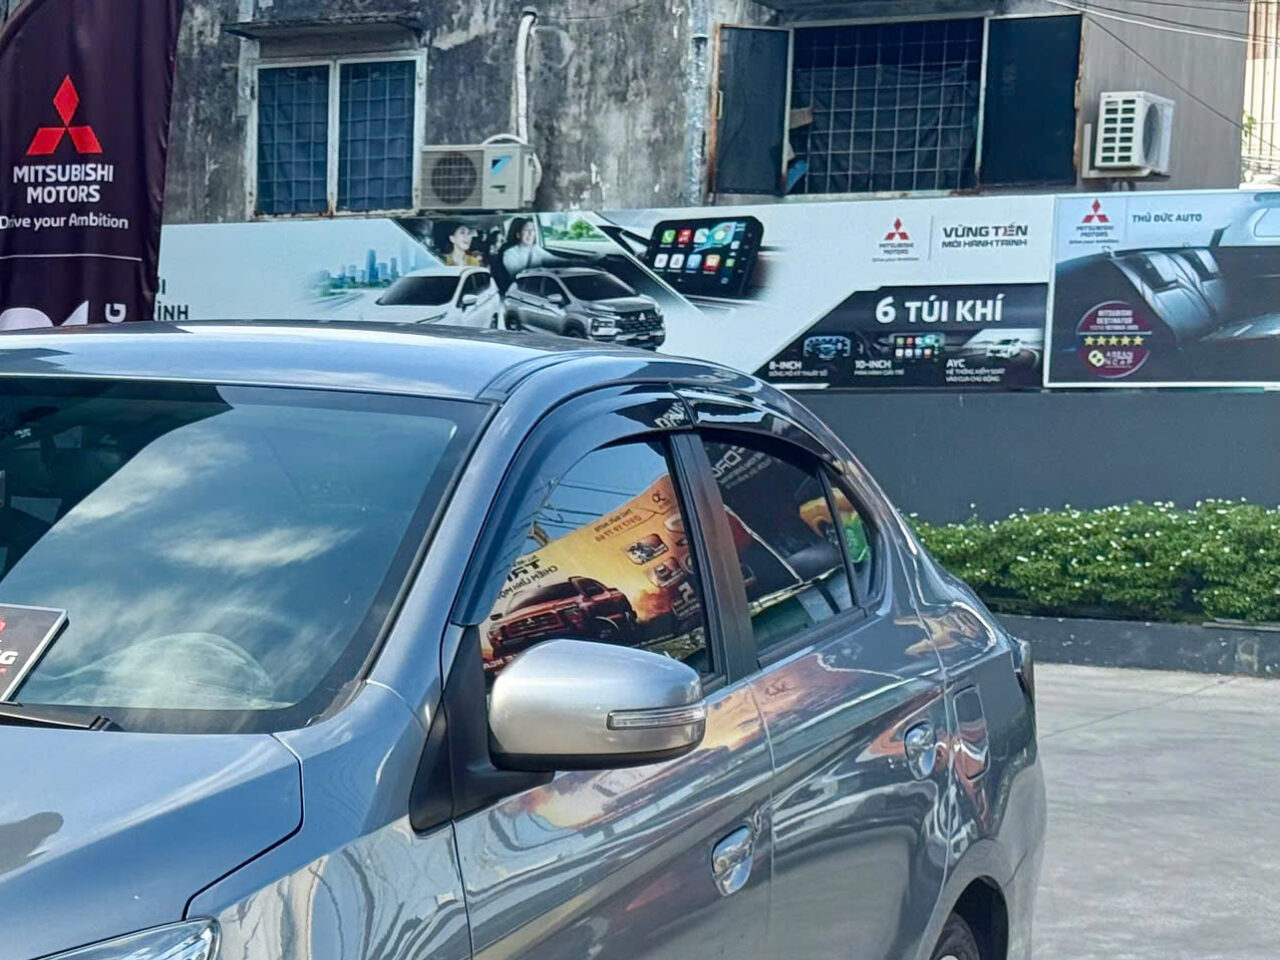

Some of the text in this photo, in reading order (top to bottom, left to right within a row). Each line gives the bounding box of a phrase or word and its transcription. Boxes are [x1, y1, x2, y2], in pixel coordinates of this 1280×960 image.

[13, 163, 114, 184] MITSUBISHI
[26, 184, 101, 204] MOTORS
[33, 215, 67, 232] your
[68, 212, 129, 230] Ambition
[1176, 213, 1203, 222] AUTO
[943, 224, 989, 238] VỮNG
[875, 292, 1005, 324] 6 TÚI KHÍ
[946, 358, 966, 368] AYC
